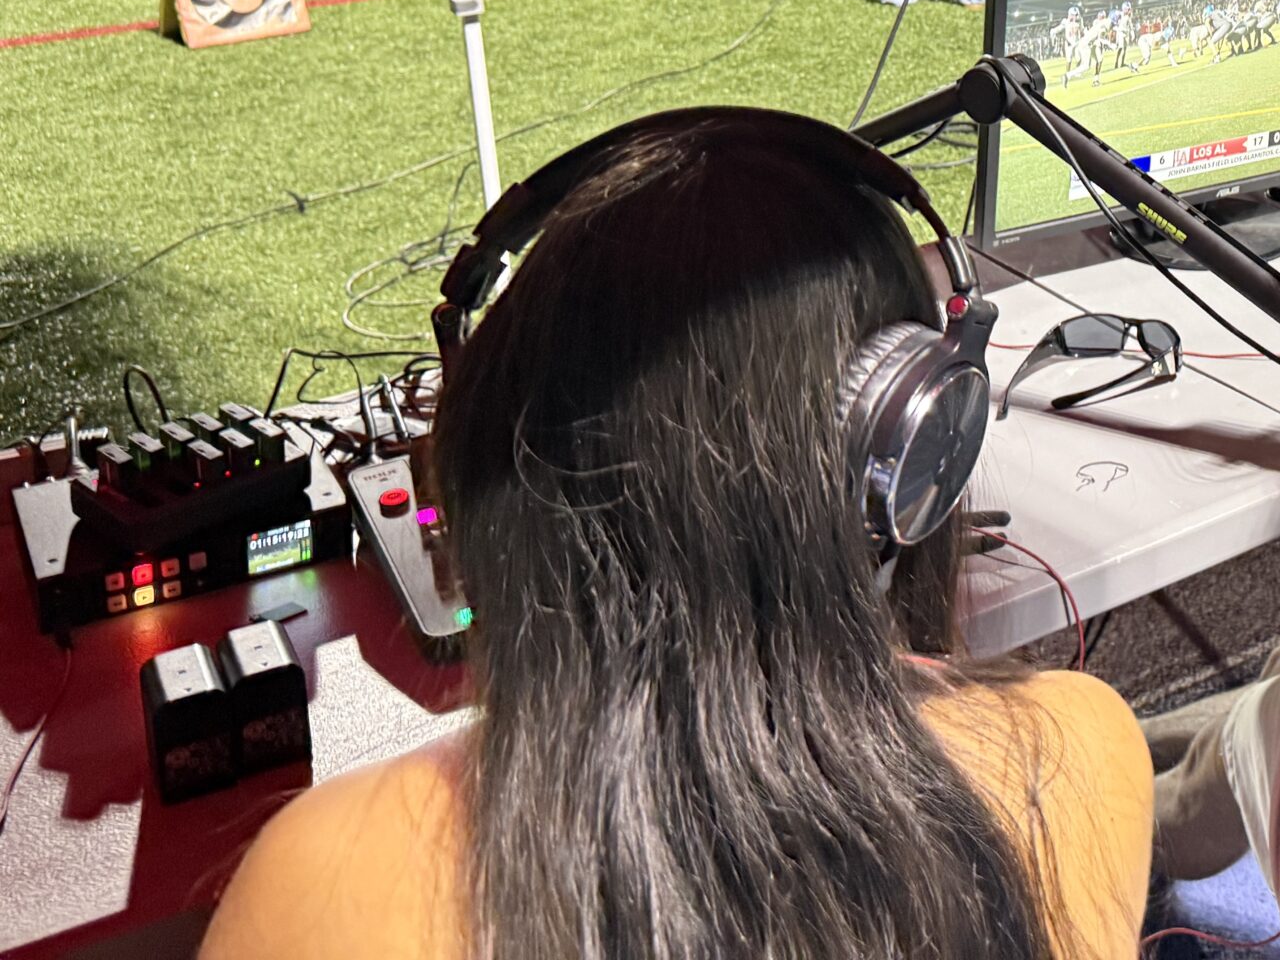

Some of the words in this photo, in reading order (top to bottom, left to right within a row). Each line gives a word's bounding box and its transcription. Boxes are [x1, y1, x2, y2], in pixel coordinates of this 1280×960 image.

[1159, 155, 1165, 165] 6
[1193, 146, 1212, 159] LOS
[1214, 143, 1227, 156] AL
[1253, 136, 1263, 146] 17
[1168, 167, 1186, 177] JOHN
[1231, 156, 1242, 164] LOS
[1137, 202, 1187, 243] SHURE
